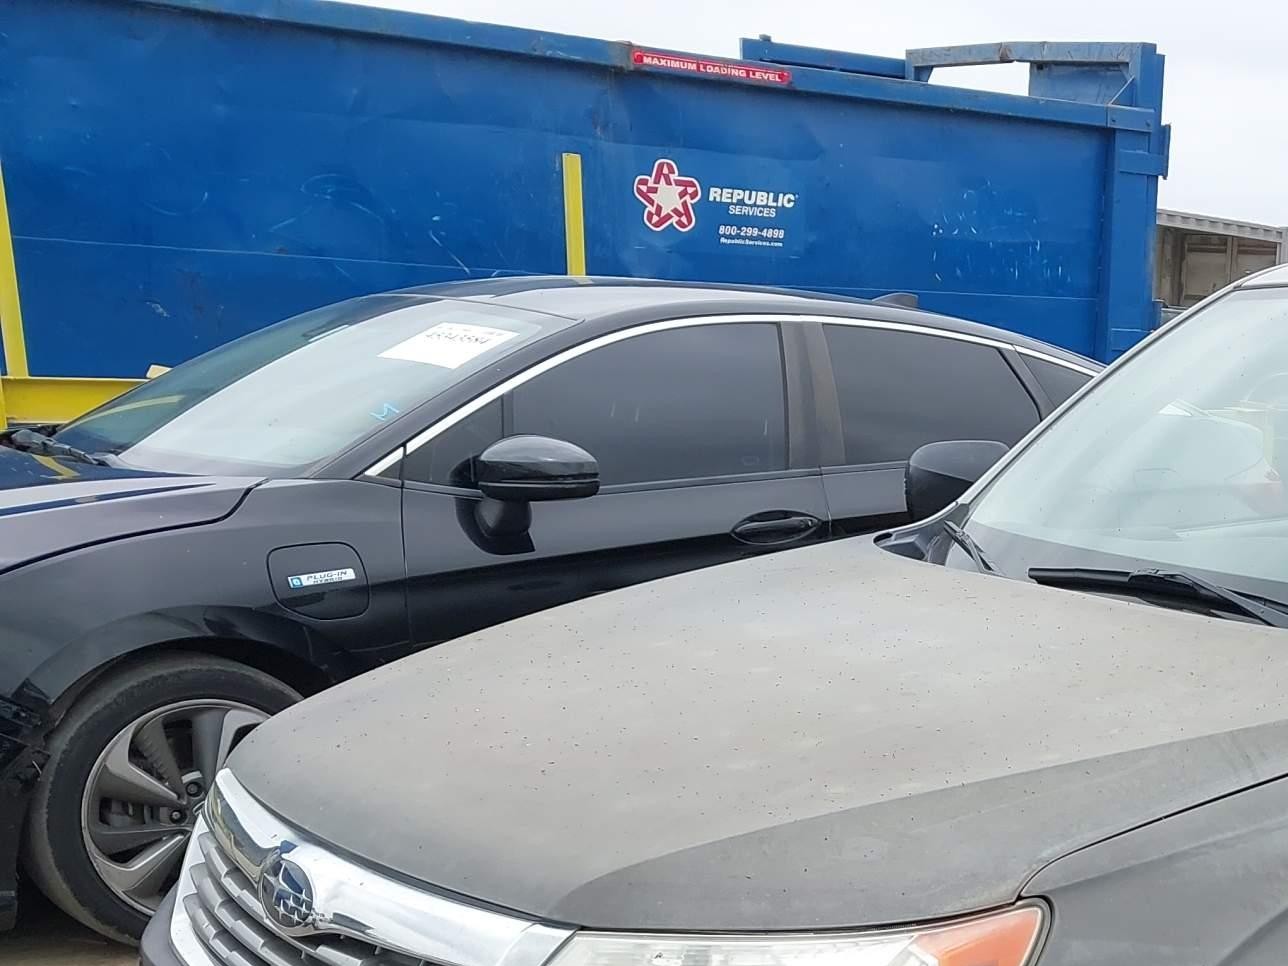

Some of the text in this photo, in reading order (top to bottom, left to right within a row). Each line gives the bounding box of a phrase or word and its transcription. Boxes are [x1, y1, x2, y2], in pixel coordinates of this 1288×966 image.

[643, 55, 782, 82] MAXIMUM LOADING LEVEL
[708, 187, 796, 208] REPUBLIC
[728, 204, 776, 218] SERVICES
[718, 225, 785, 239] 800-299-4898
[306, 570, 348, 581] PLUG-IN
